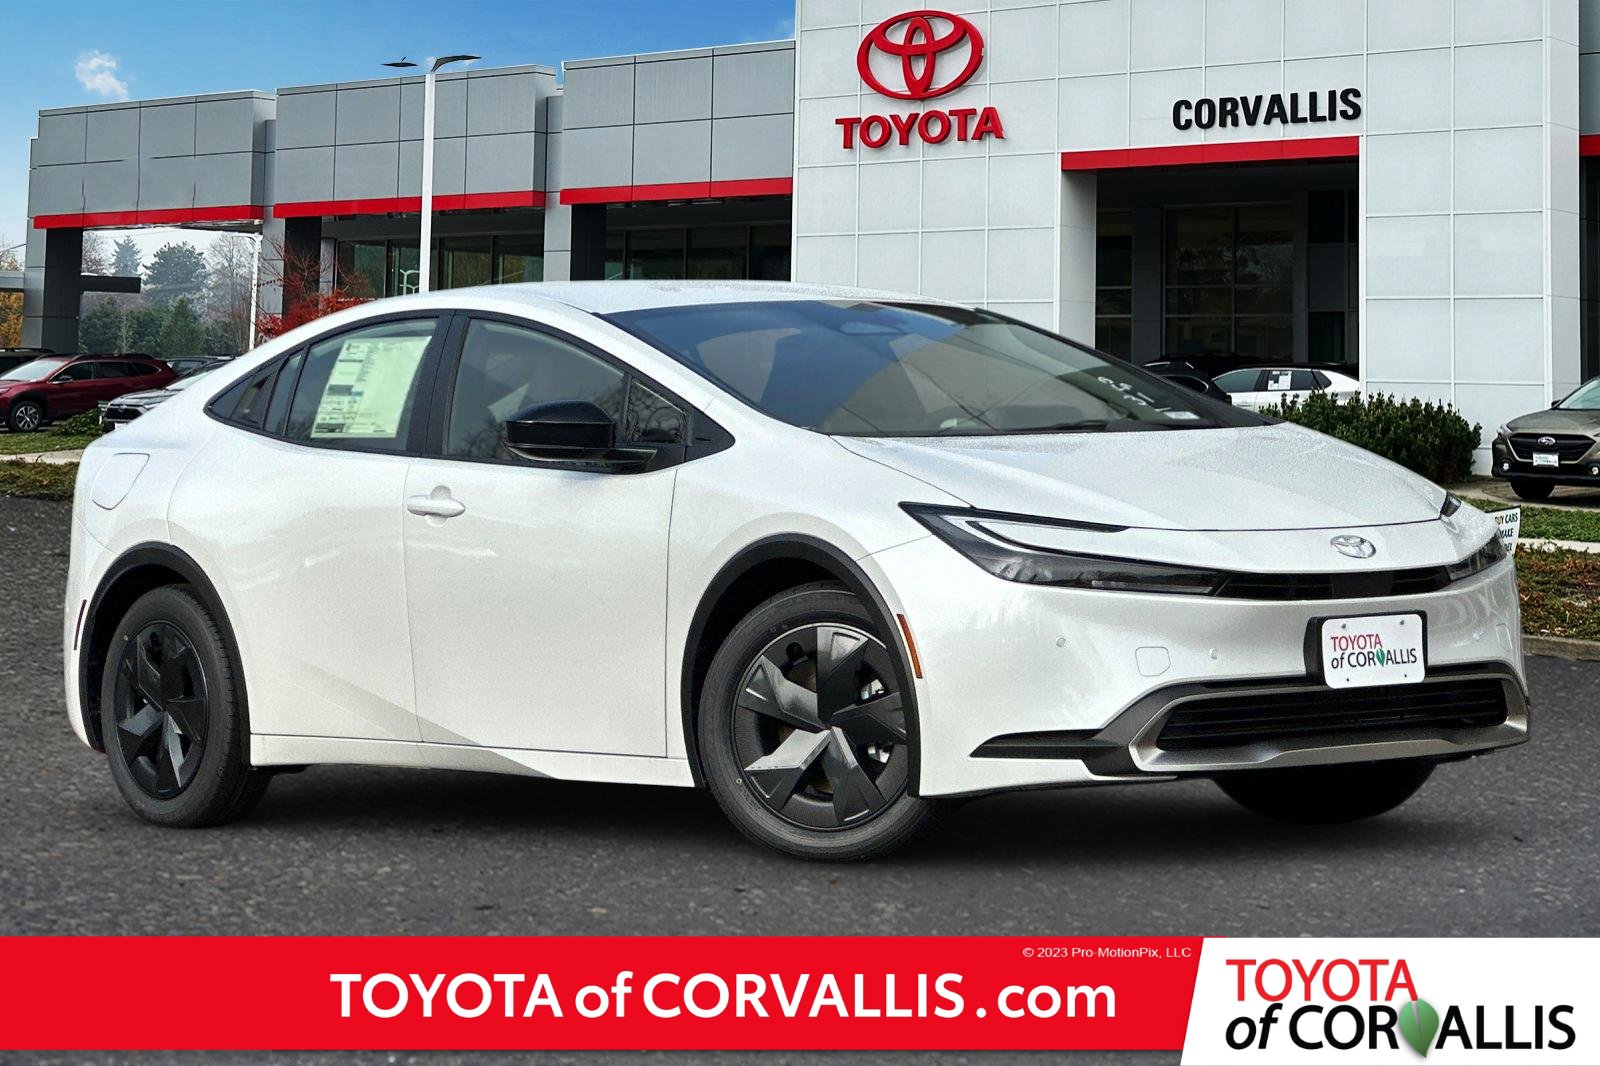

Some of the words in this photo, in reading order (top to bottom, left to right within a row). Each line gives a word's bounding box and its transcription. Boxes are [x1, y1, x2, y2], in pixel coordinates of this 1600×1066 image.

[1172, 87, 1362, 131] CORVALLIS
[836, 106, 1005, 149] TOYOTA
[1330, 633, 1383, 652] TOYOTA
[1331, 653, 1345, 669] of
